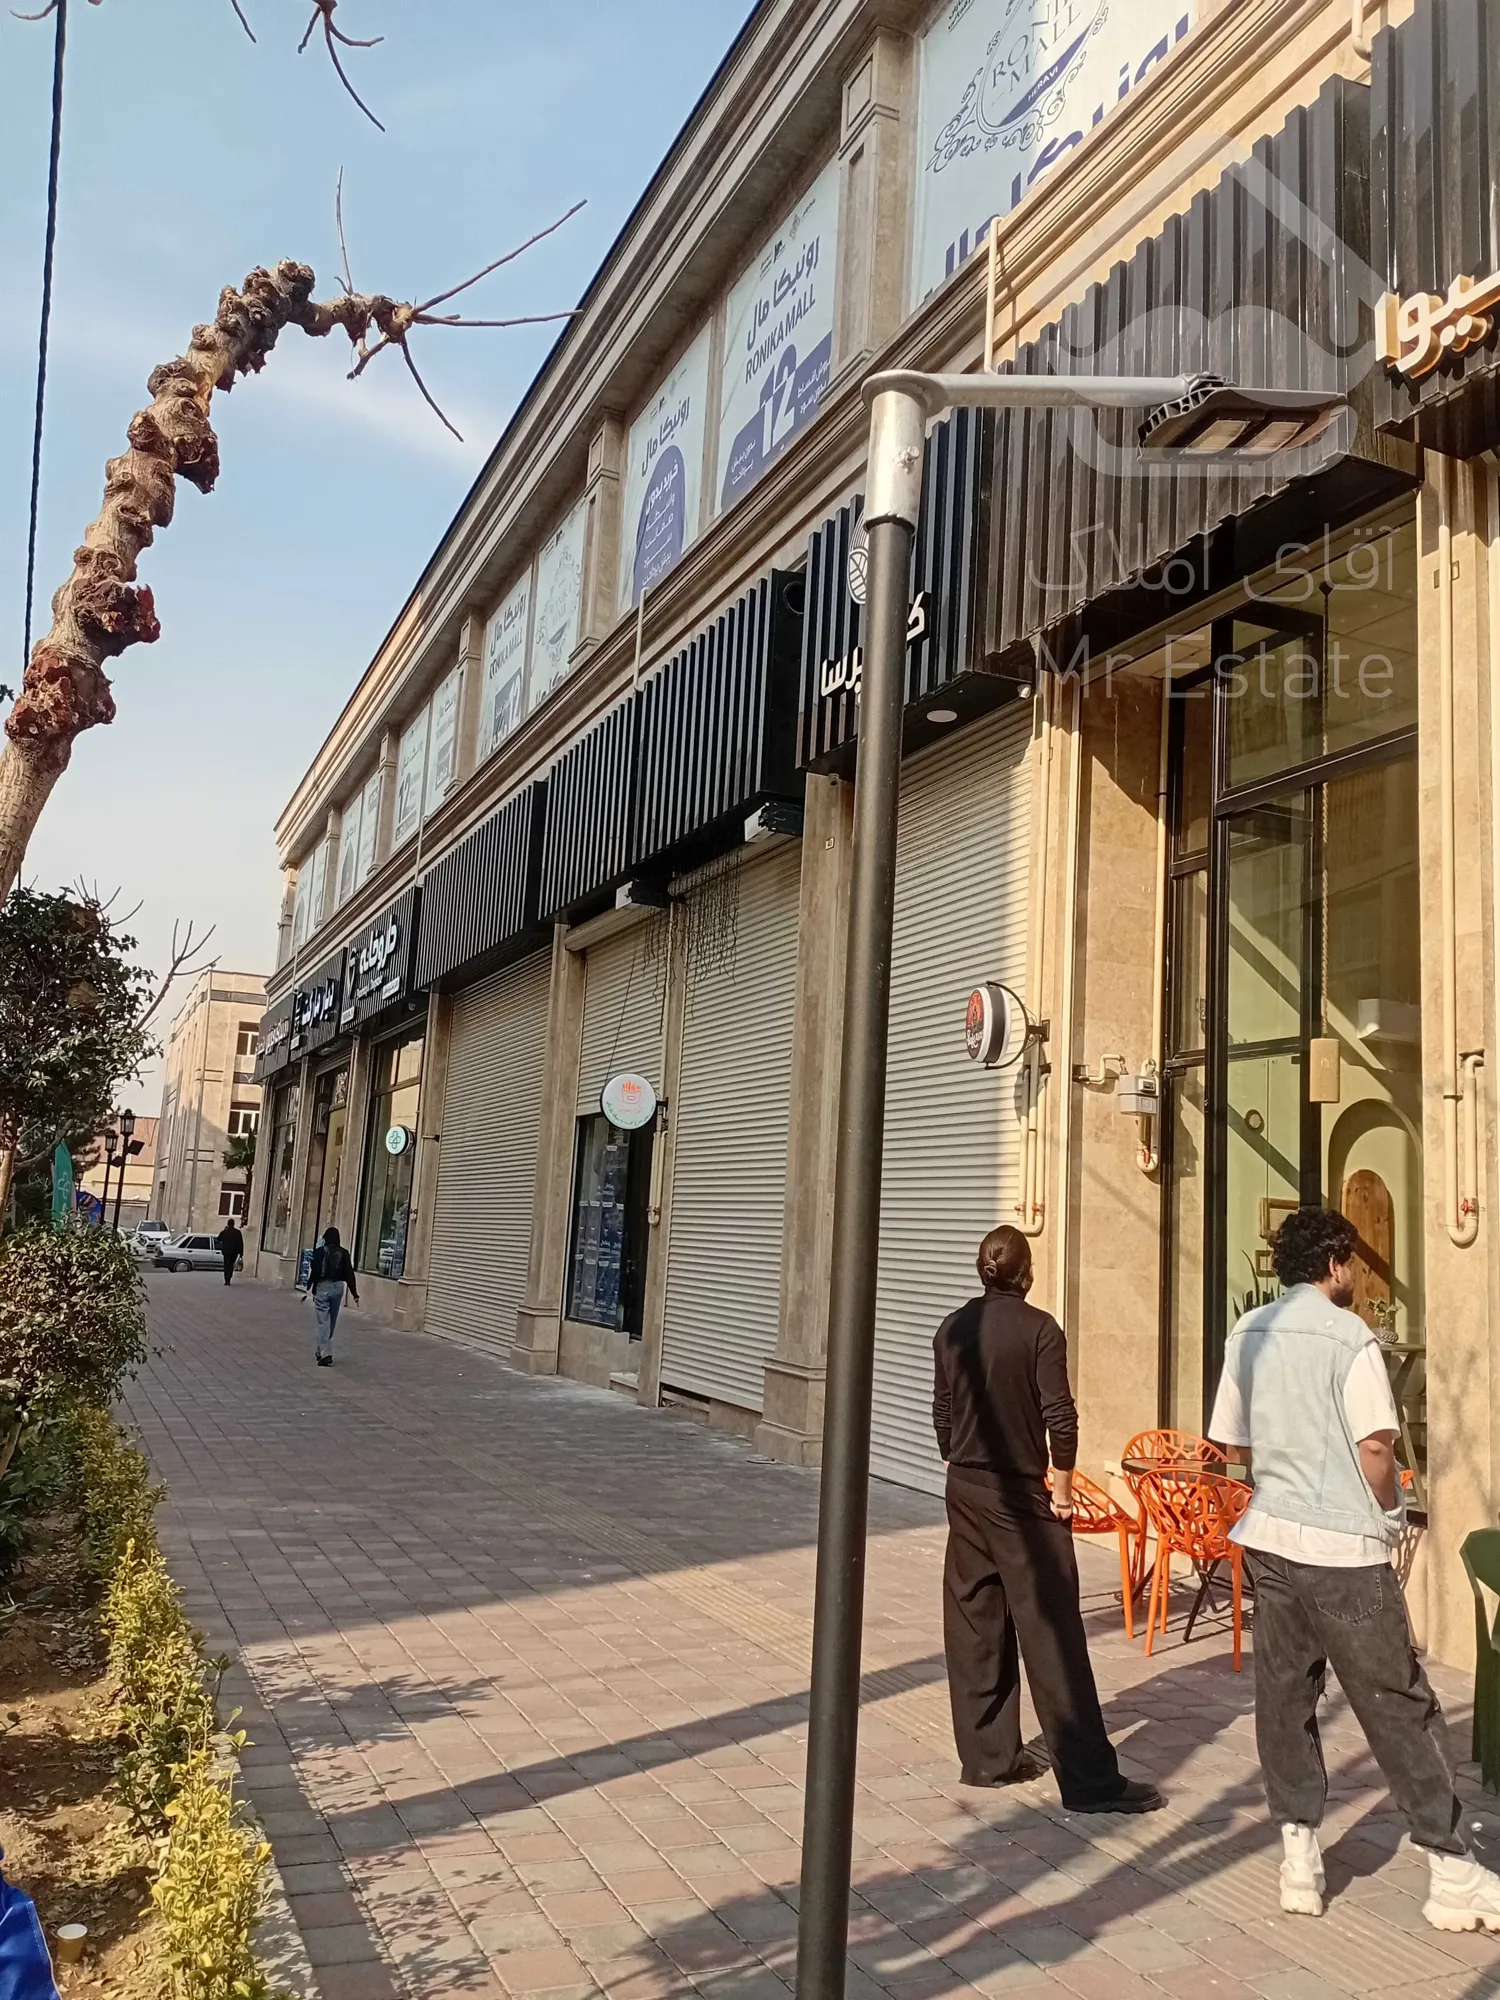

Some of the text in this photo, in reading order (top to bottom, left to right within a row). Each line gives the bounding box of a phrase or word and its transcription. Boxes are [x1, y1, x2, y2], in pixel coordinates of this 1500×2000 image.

[992, 0, 1068, 89] RONI
[1009, 3, 1081, 92] MALL
[1028, 65, 1059, 101] HERAVI
[773, 235, 820, 308] رونیکا
[746, 320, 785, 384] RONIKA
[785, 283, 816, 337] MALL
[747, 298, 770, 351] مال
[1374, 268, 1500, 378] یوا
[659, 396, 690, 444] رونیکا
[760, 343, 797, 458] 12
[641, 437, 658, 477] مال
[662, 458, 679, 492] خرید
